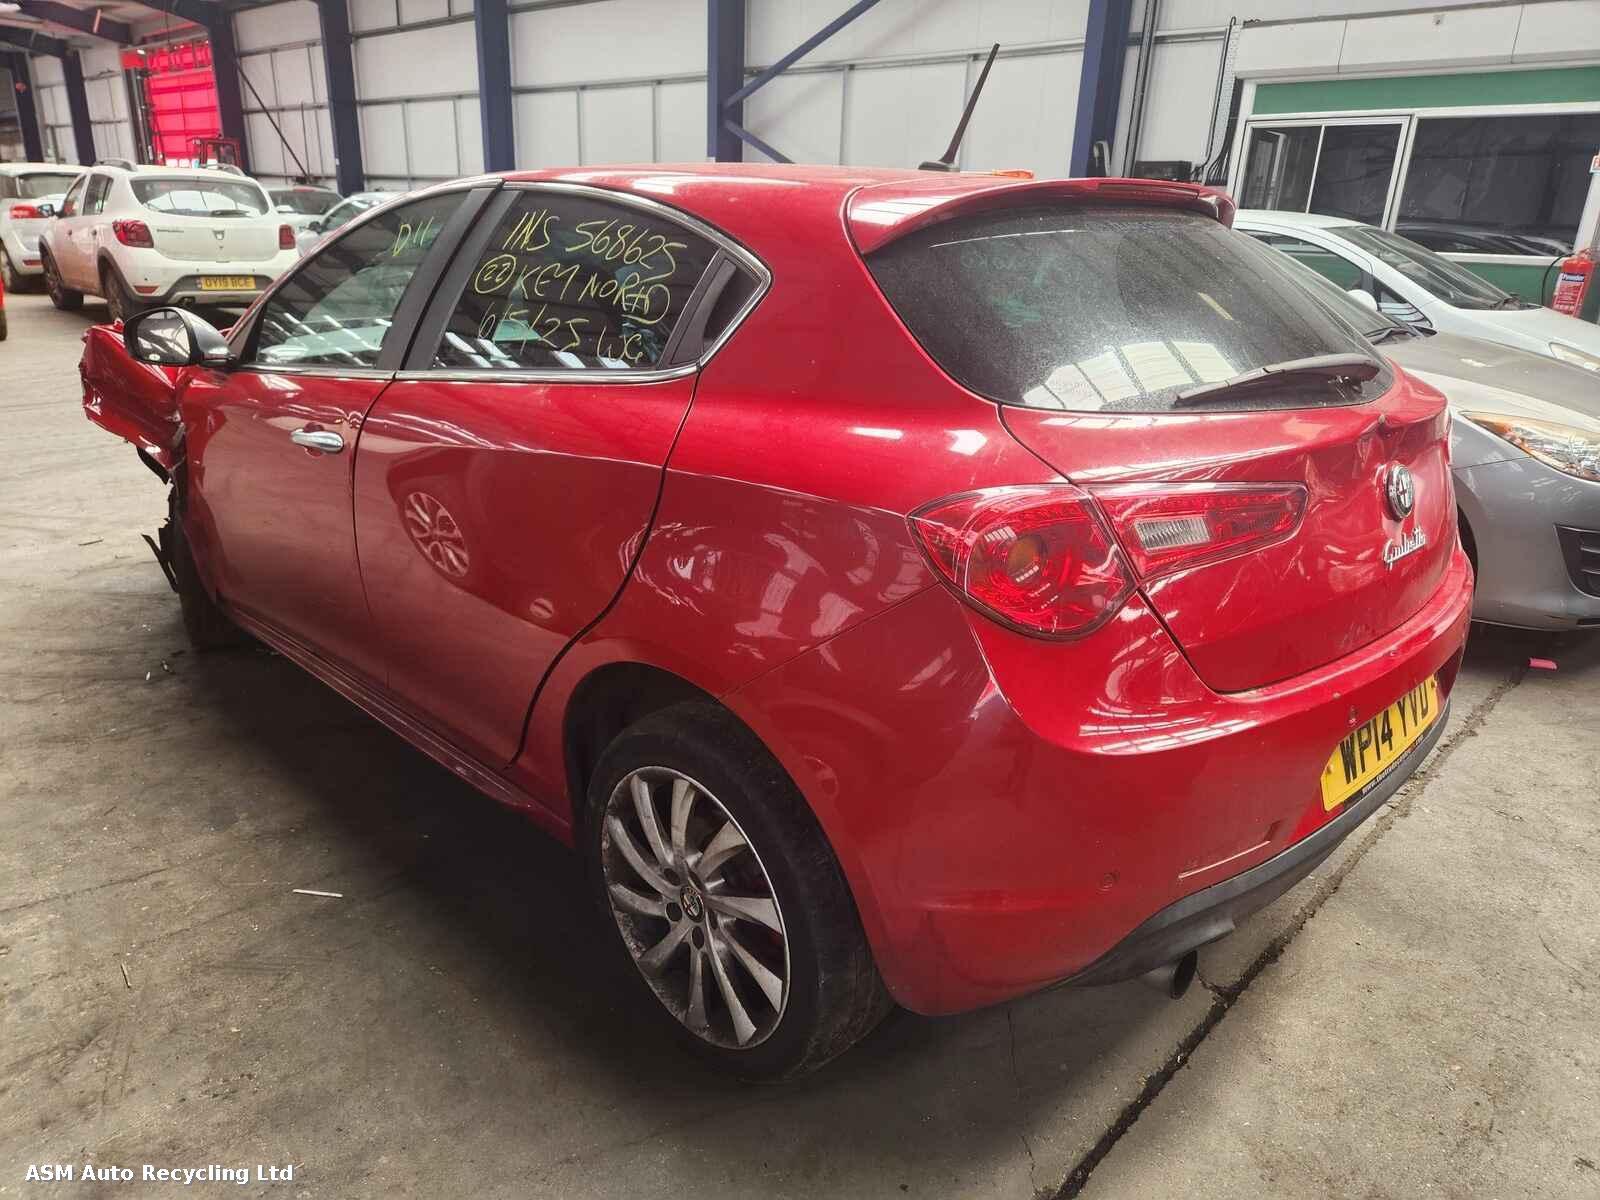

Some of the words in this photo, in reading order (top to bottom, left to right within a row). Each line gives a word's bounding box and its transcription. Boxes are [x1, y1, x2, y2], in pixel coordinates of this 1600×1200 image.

[502, 208, 561, 252] INS
[564, 218, 688, 285] 568625
[511, 263, 580, 301] KEY
[1338, 709, 1394, 785] WP14
